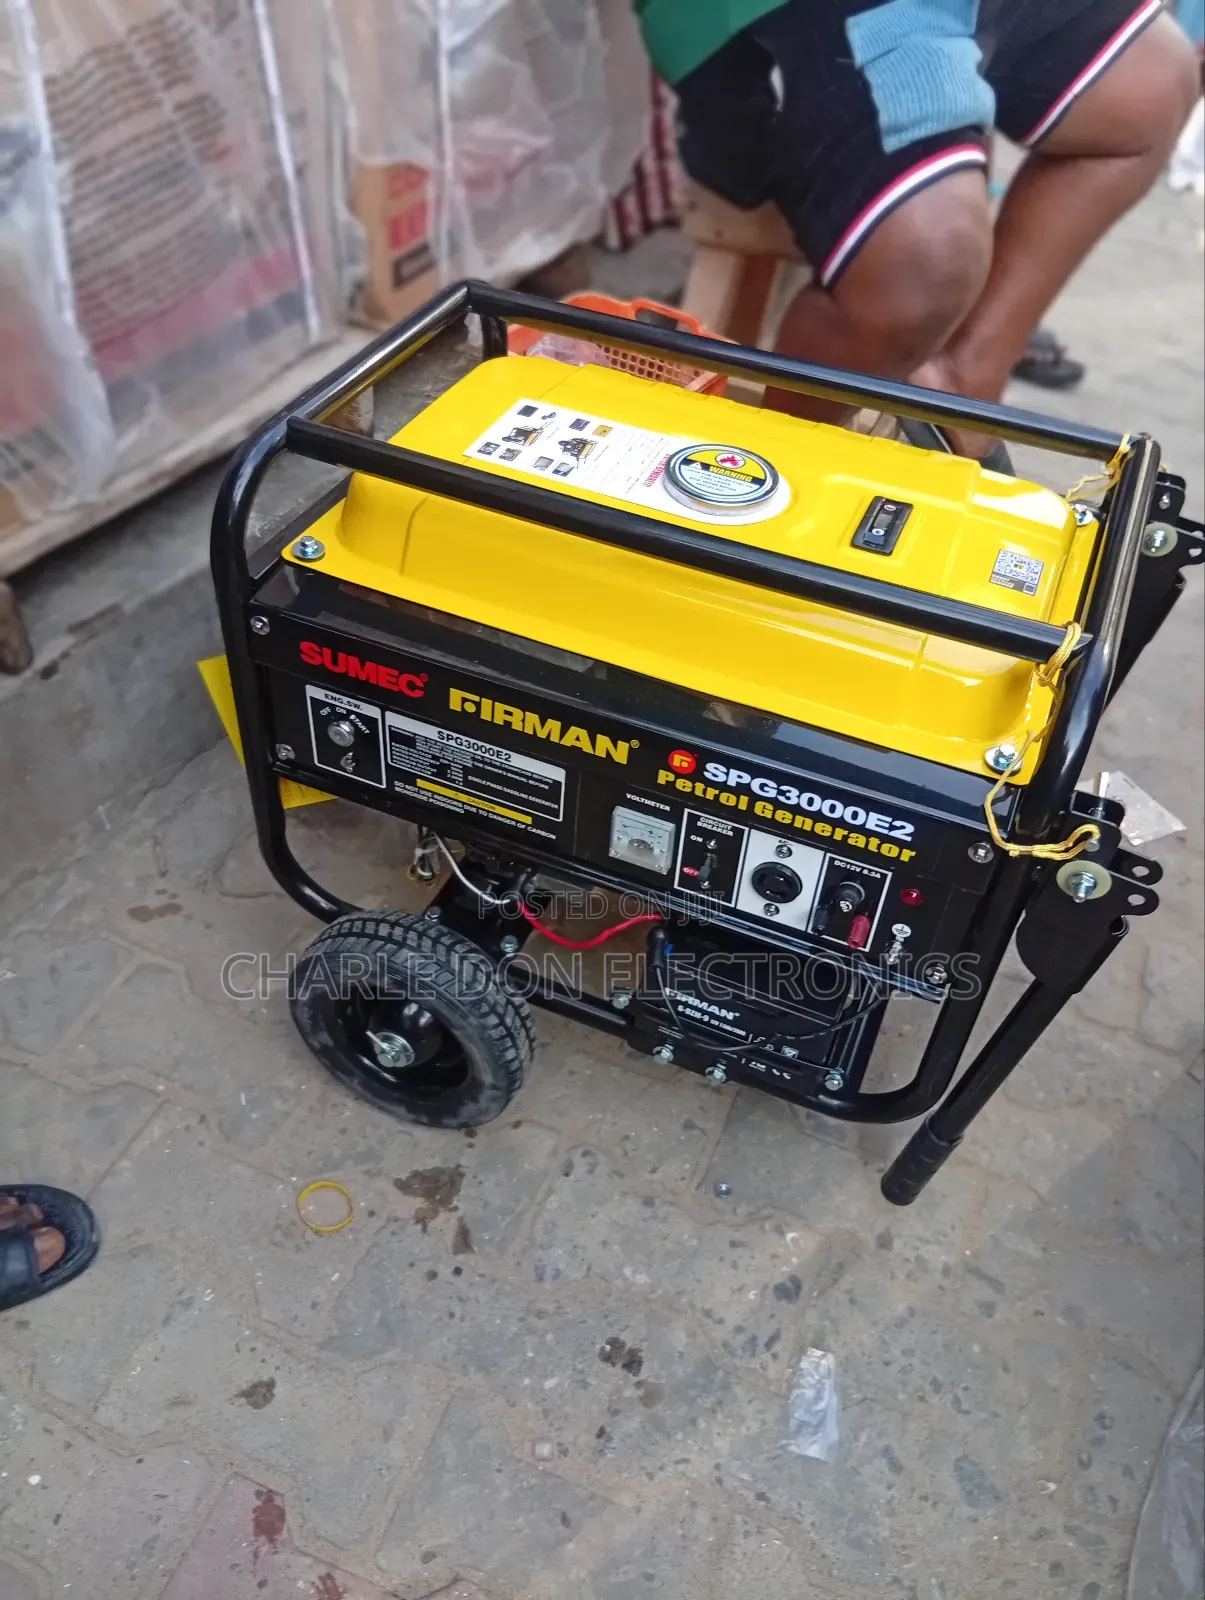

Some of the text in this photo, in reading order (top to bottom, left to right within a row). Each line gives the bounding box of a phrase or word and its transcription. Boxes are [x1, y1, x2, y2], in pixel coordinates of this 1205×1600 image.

[709, 465, 753, 483] WARNING
[437, 730, 512, 763] SPG3000E2
[467, 797, 497, 811] CAUTION
[626, 793, 671, 811] VOLTMETER
[703, 762, 915, 842] SPG3000E2
[657, 769, 916, 863] Petrol Generator
[700, 817, 732, 831] CIRCUIT
[697, 821, 734, 837] BREAKER
[690, 834, 703, 843] ON
[834, 860, 862, 872] DC12V
